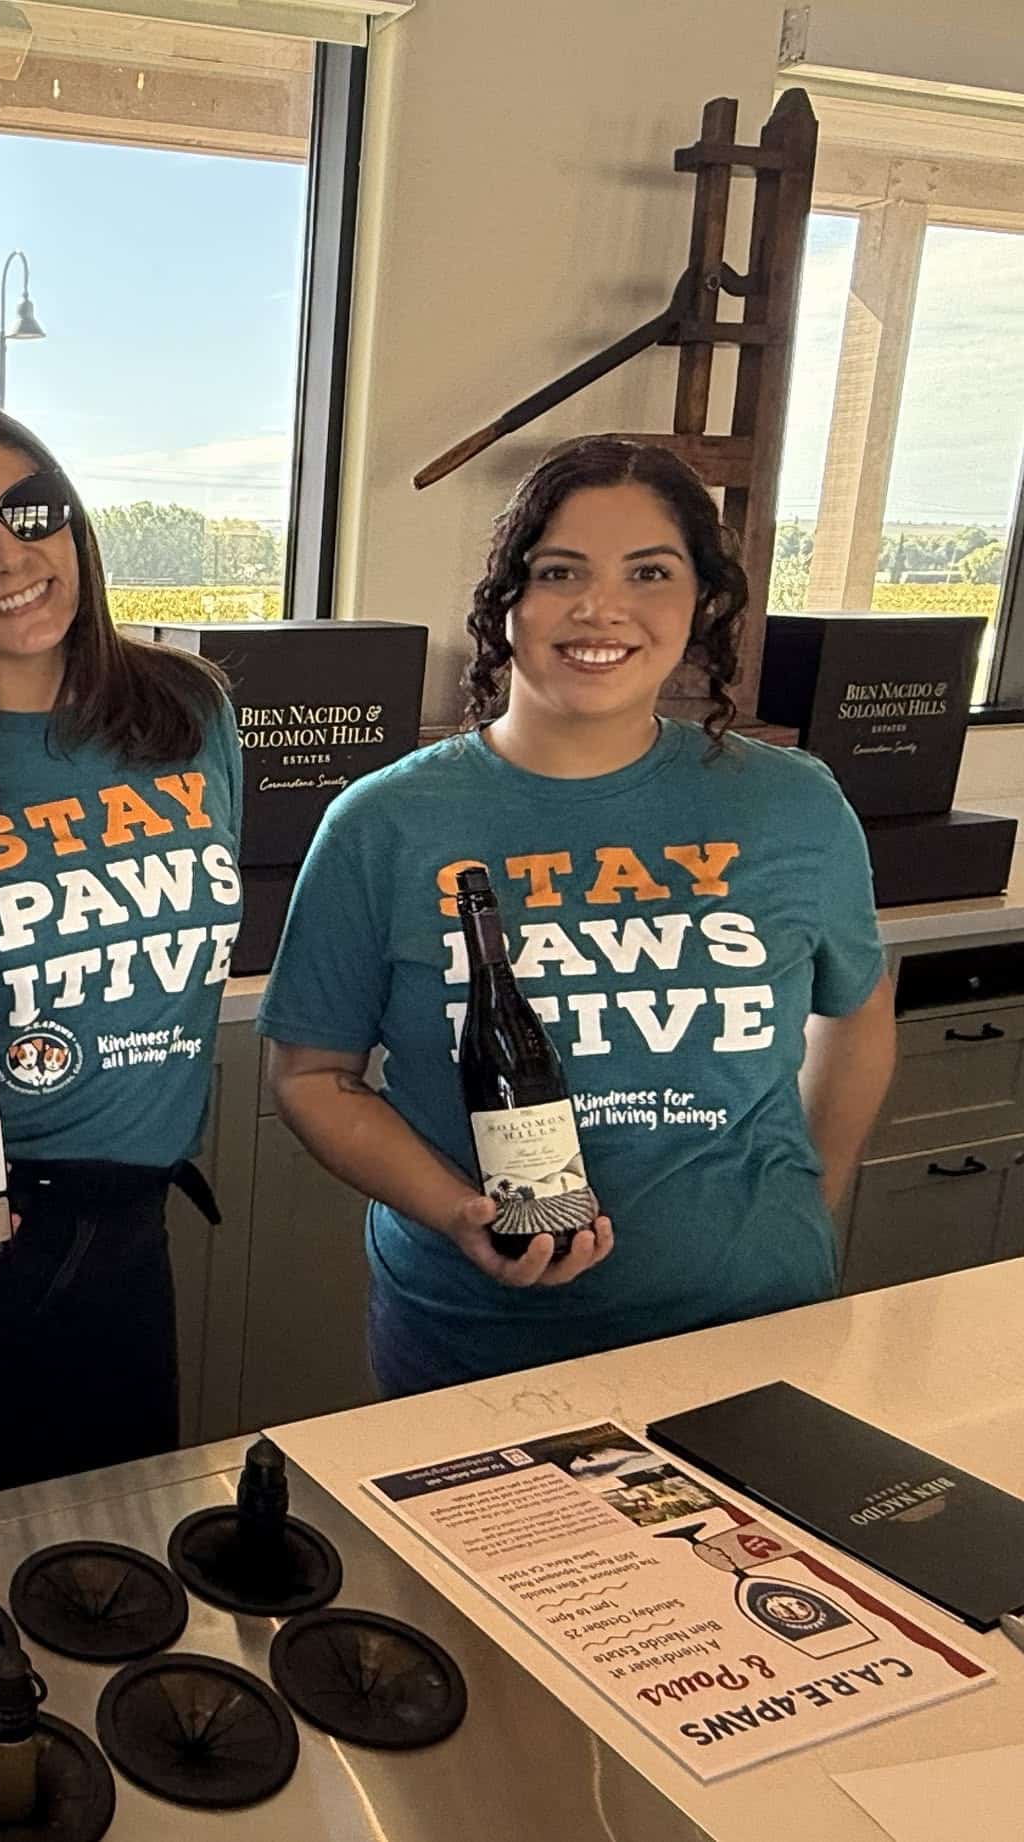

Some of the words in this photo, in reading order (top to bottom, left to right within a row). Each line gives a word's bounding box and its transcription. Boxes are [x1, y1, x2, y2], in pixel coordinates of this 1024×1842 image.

[845, 683, 878, 701] BIEN
[879, 682, 932, 699] NACIDO
[240, 706, 284, 727] BIEN
[289, 705, 361, 725] NACIDO
[366, 705, 383, 722] &
[838, 701, 907, 719] SOLOMON
[907, 699, 946, 716] HILLS
[237, 728, 327, 749] SOLOMON
[331, 726, 384, 745] HILLS
[283, 754, 331, 765] ESTATES
[3, 922, 240, 1027] ITIVE
[446, 985, 774, 1063] IVE
[97, 1030, 169, 1054] Kindness
[102, 1051, 124, 1069] all
[573, 1090, 656, 1113] Kindness
[663, 1088, 695, 1106] for
[487, 1114, 566, 1132] SOLOMON
[580, 1110, 600, 1128] all
[605, 1106, 657, 1131] living
[663, 1107, 727, 1131] beings
[912, 1476, 956, 1499] BIEN
[849, 1494, 918, 1526] NACIDO
[573, 1606, 593, 1617] to
[586, 1598, 620, 1613] 1pm
[625, 1596, 686, 1620] Saturday,
[543, 1610, 578, 1626] 4pm
[578, 1613, 633, 1635] October
[685, 1619, 724, 1637] Bien
[560, 1628, 583, 1639] 25
[635, 1629, 692, 1652] Nacido
[703, 1638, 725, 1650] A
[590, 1644, 642, 1666] Estate
[624, 1642, 711, 1677] friendraiser
[737, 1652, 784, 1680] &
[607, 1667, 629, 1679] at
[631, 1661, 755, 1716] Pours
[674, 1654, 918, 1749] C.A.R.E.4PAWS
